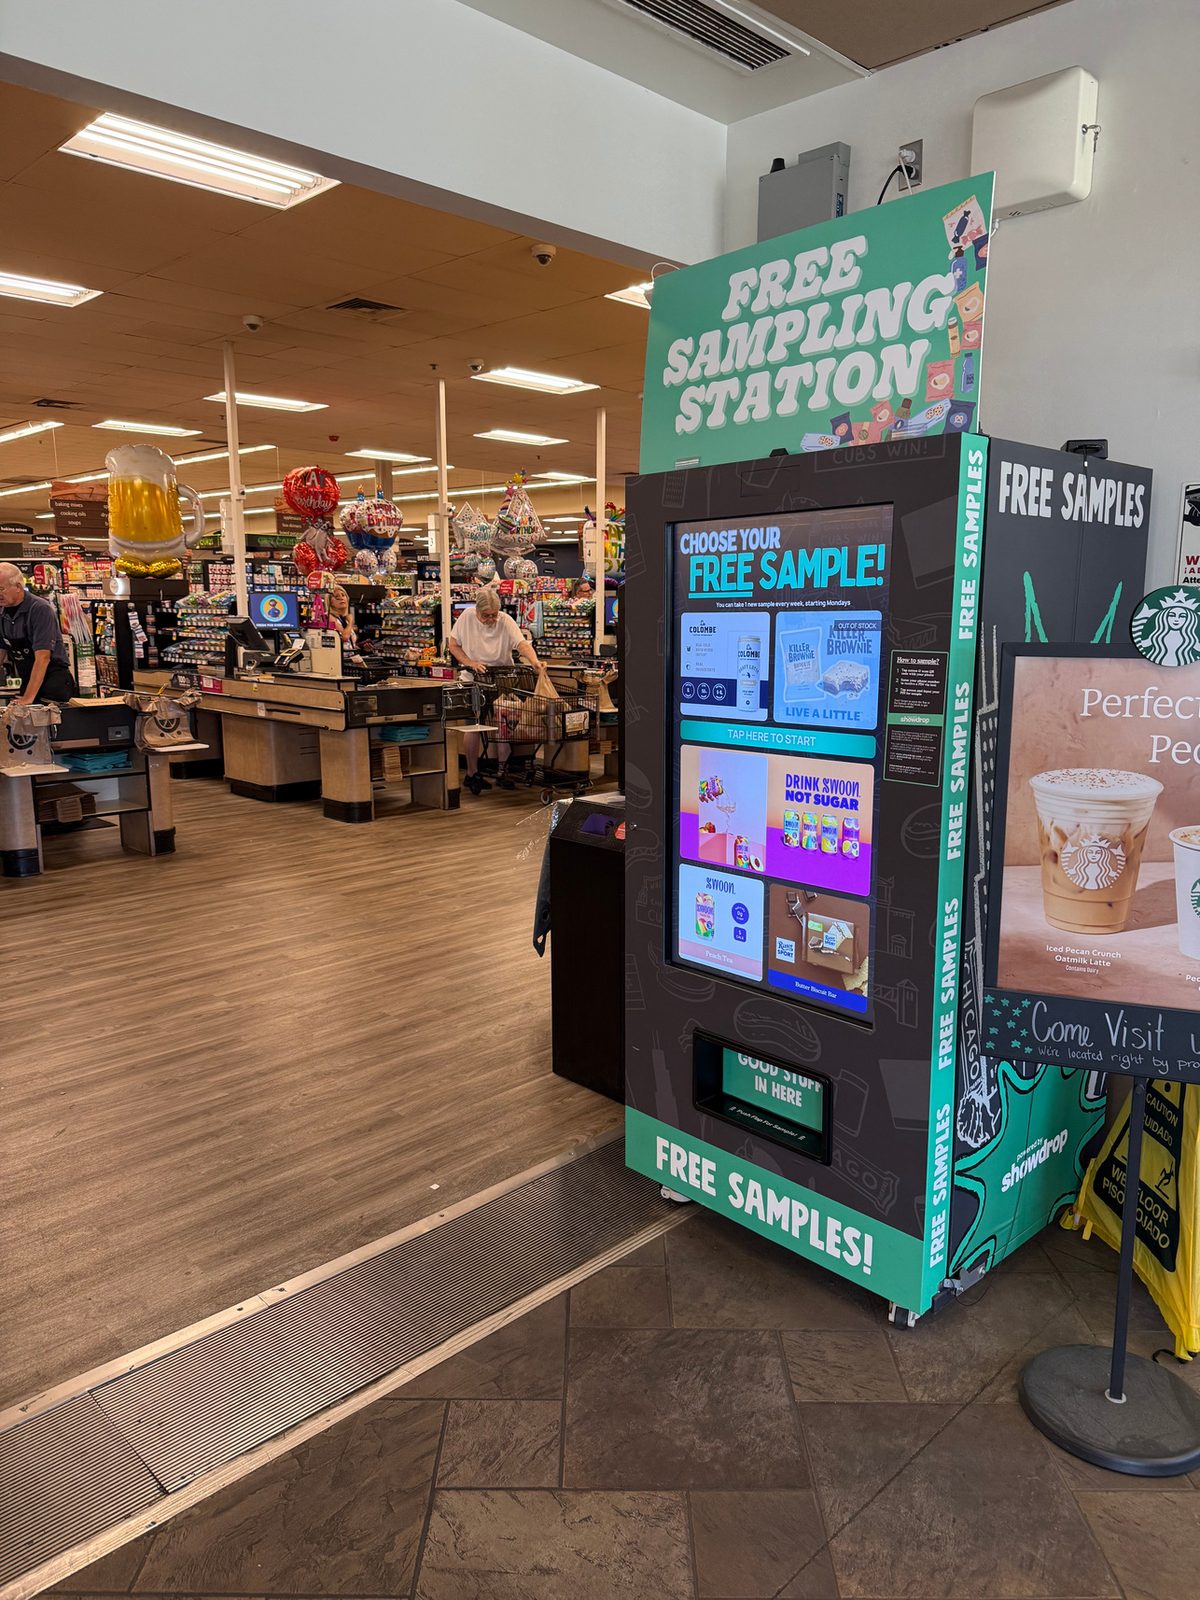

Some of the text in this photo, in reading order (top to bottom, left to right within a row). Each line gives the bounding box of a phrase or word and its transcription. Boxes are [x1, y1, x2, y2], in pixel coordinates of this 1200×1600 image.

[721, 235, 868, 321] FREE
[663, 272, 955, 387] SAMPLING
[674, 339, 930, 435] STATION
[833, 439, 928, 464] CUBS WIN!
[998, 460, 1145, 529] FREE SAMPLES
[679, 526, 781, 555] CHOOSE YOUR
[958, 449, 984, 640] FREE SAMPLES
[689, 543, 886, 592] FREE SAMPLE!
[757, 601, 775, 609] sample
[805, 600, 826, 608] starting
[689, 626, 717, 634] COLOMBE
[788, 642, 810, 653] KILLER
[896, 656, 910, 664] How
[917, 657, 940, 666] sample?
[785, 706, 861, 721] LIVE A LITTLE
[900, 716, 930, 724] showdrop
[727, 729, 816, 747] TAP HERE TO START
[785, 773, 819, 793] DRINK
[946, 681, 970, 861] FREE SAMPLES
[785, 790, 859, 811] NOT SUGAR
[705, 950, 722, 961] Peach
[777, 949, 794, 958] SPORT
[1046, 944, 1122, 959] Iced Pecan Crunch
[1055, 955, 1111, 967] Oatmilk Latte
[1065, 964, 1099, 975] Contains Dairy
[794, 981, 811, 992] Butter
[827, 990, 838, 999] Bar
[938, 897, 959, 1070] FREE SAMPLES
[1032, 1000, 1094, 1048] Come
[1104, 1009, 1165, 1051] Visit
[737, 1052, 779, 1076] GOOD
[1068, 1048, 1104, 1061] located
[1111, 1053, 1145, 1070] right
[1152, 1056, 1169, 1075] by
[754, 1075, 803, 1107] IN HERE
[736, 1109, 798, 1137] Push Flap For Sample!
[1145, 1093, 1179, 1127] CAUTION
[1142, 1112, 1173, 1147] UIDADO
[1001, 1128, 1068, 1193] showdrop
[929, 1103, 951, 1268] FREE SAMPLES
[1111, 1163, 1127, 1188] WE
[656, 1135, 873, 1275] FREE SAMPLES!
[1102, 1177, 1170, 1249] PISO OJADO
